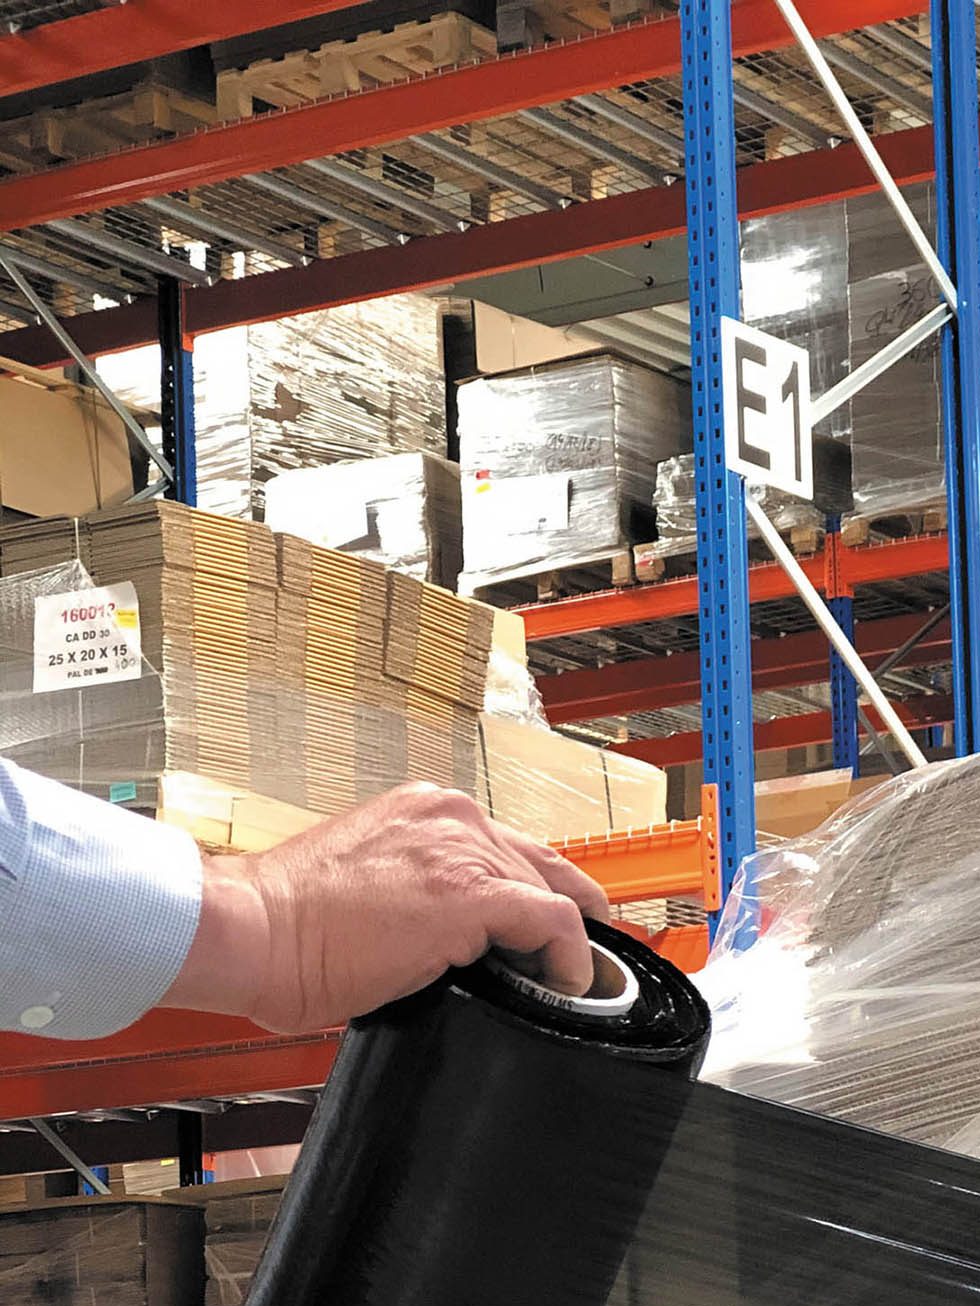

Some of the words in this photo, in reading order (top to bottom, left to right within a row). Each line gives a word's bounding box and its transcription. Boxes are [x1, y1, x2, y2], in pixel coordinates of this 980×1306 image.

[735, 336, 802, 482] E1
[65, 633, 79, 643] CA
[82, 630, 96, 640] DD
[49, 654, 63, 666] 25
[68, 651, 76, 663] X
[80, 649, 95, 661] 20
[99, 647, 108, 658] X
[112, 644, 127, 656] 15
